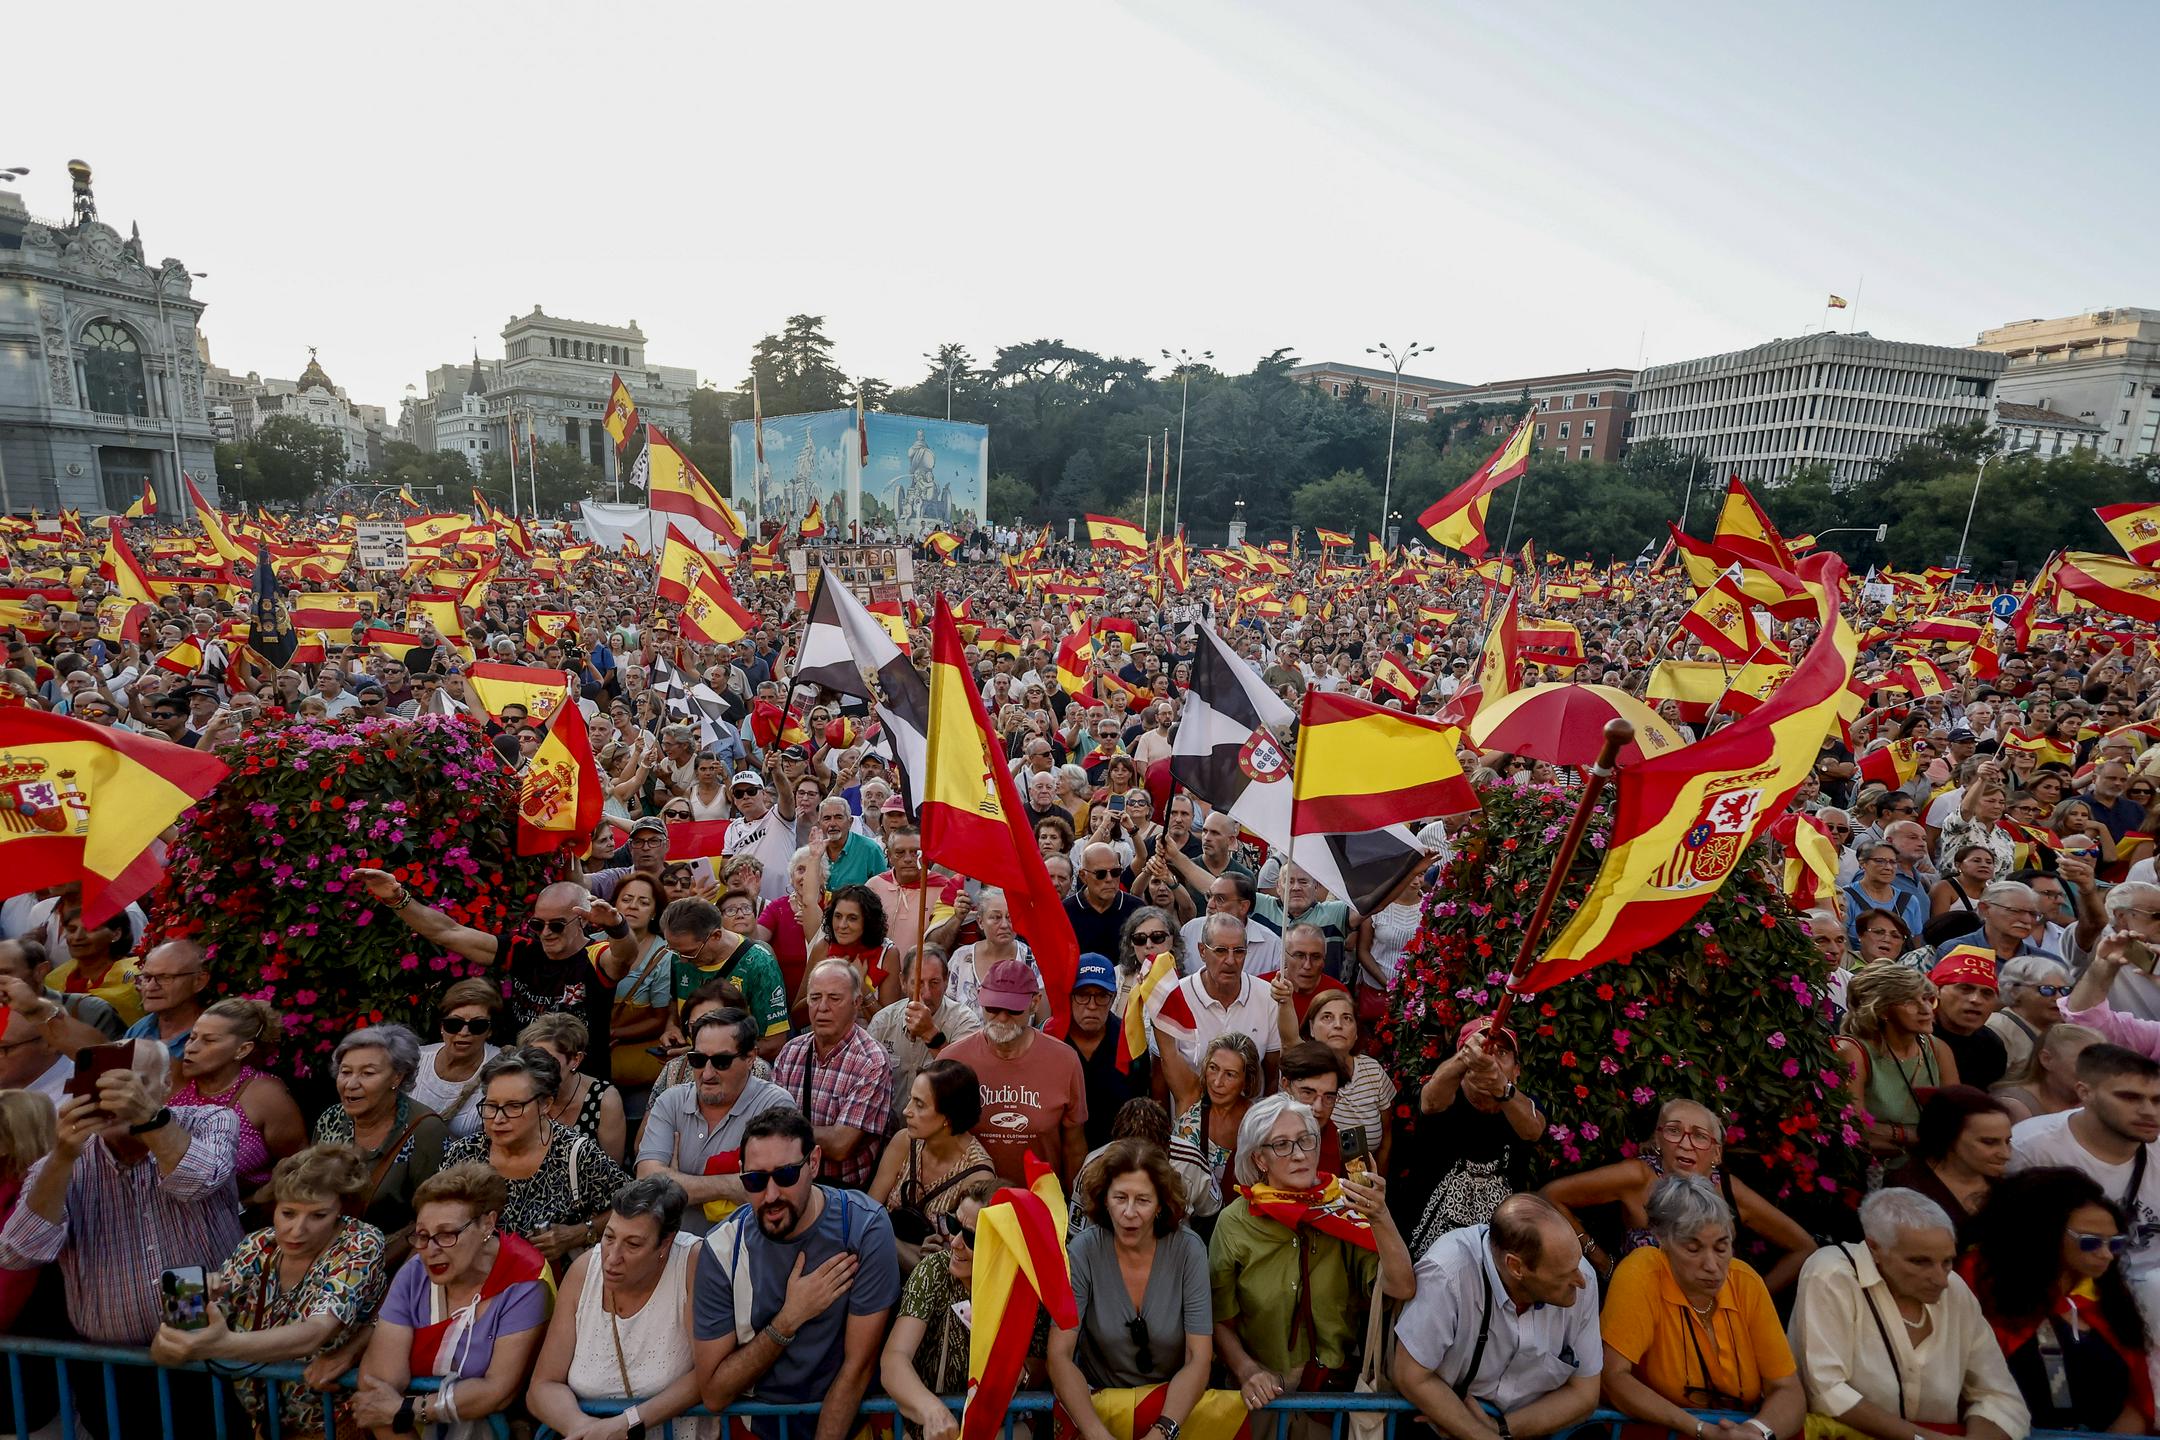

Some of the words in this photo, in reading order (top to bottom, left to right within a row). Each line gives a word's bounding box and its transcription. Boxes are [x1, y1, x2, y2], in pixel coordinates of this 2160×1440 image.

[1080, 965, 1106, 974] SPORT
[979, 1084, 1019, 1108] Studio
[1020, 1085, 1042, 1109] Inc.
